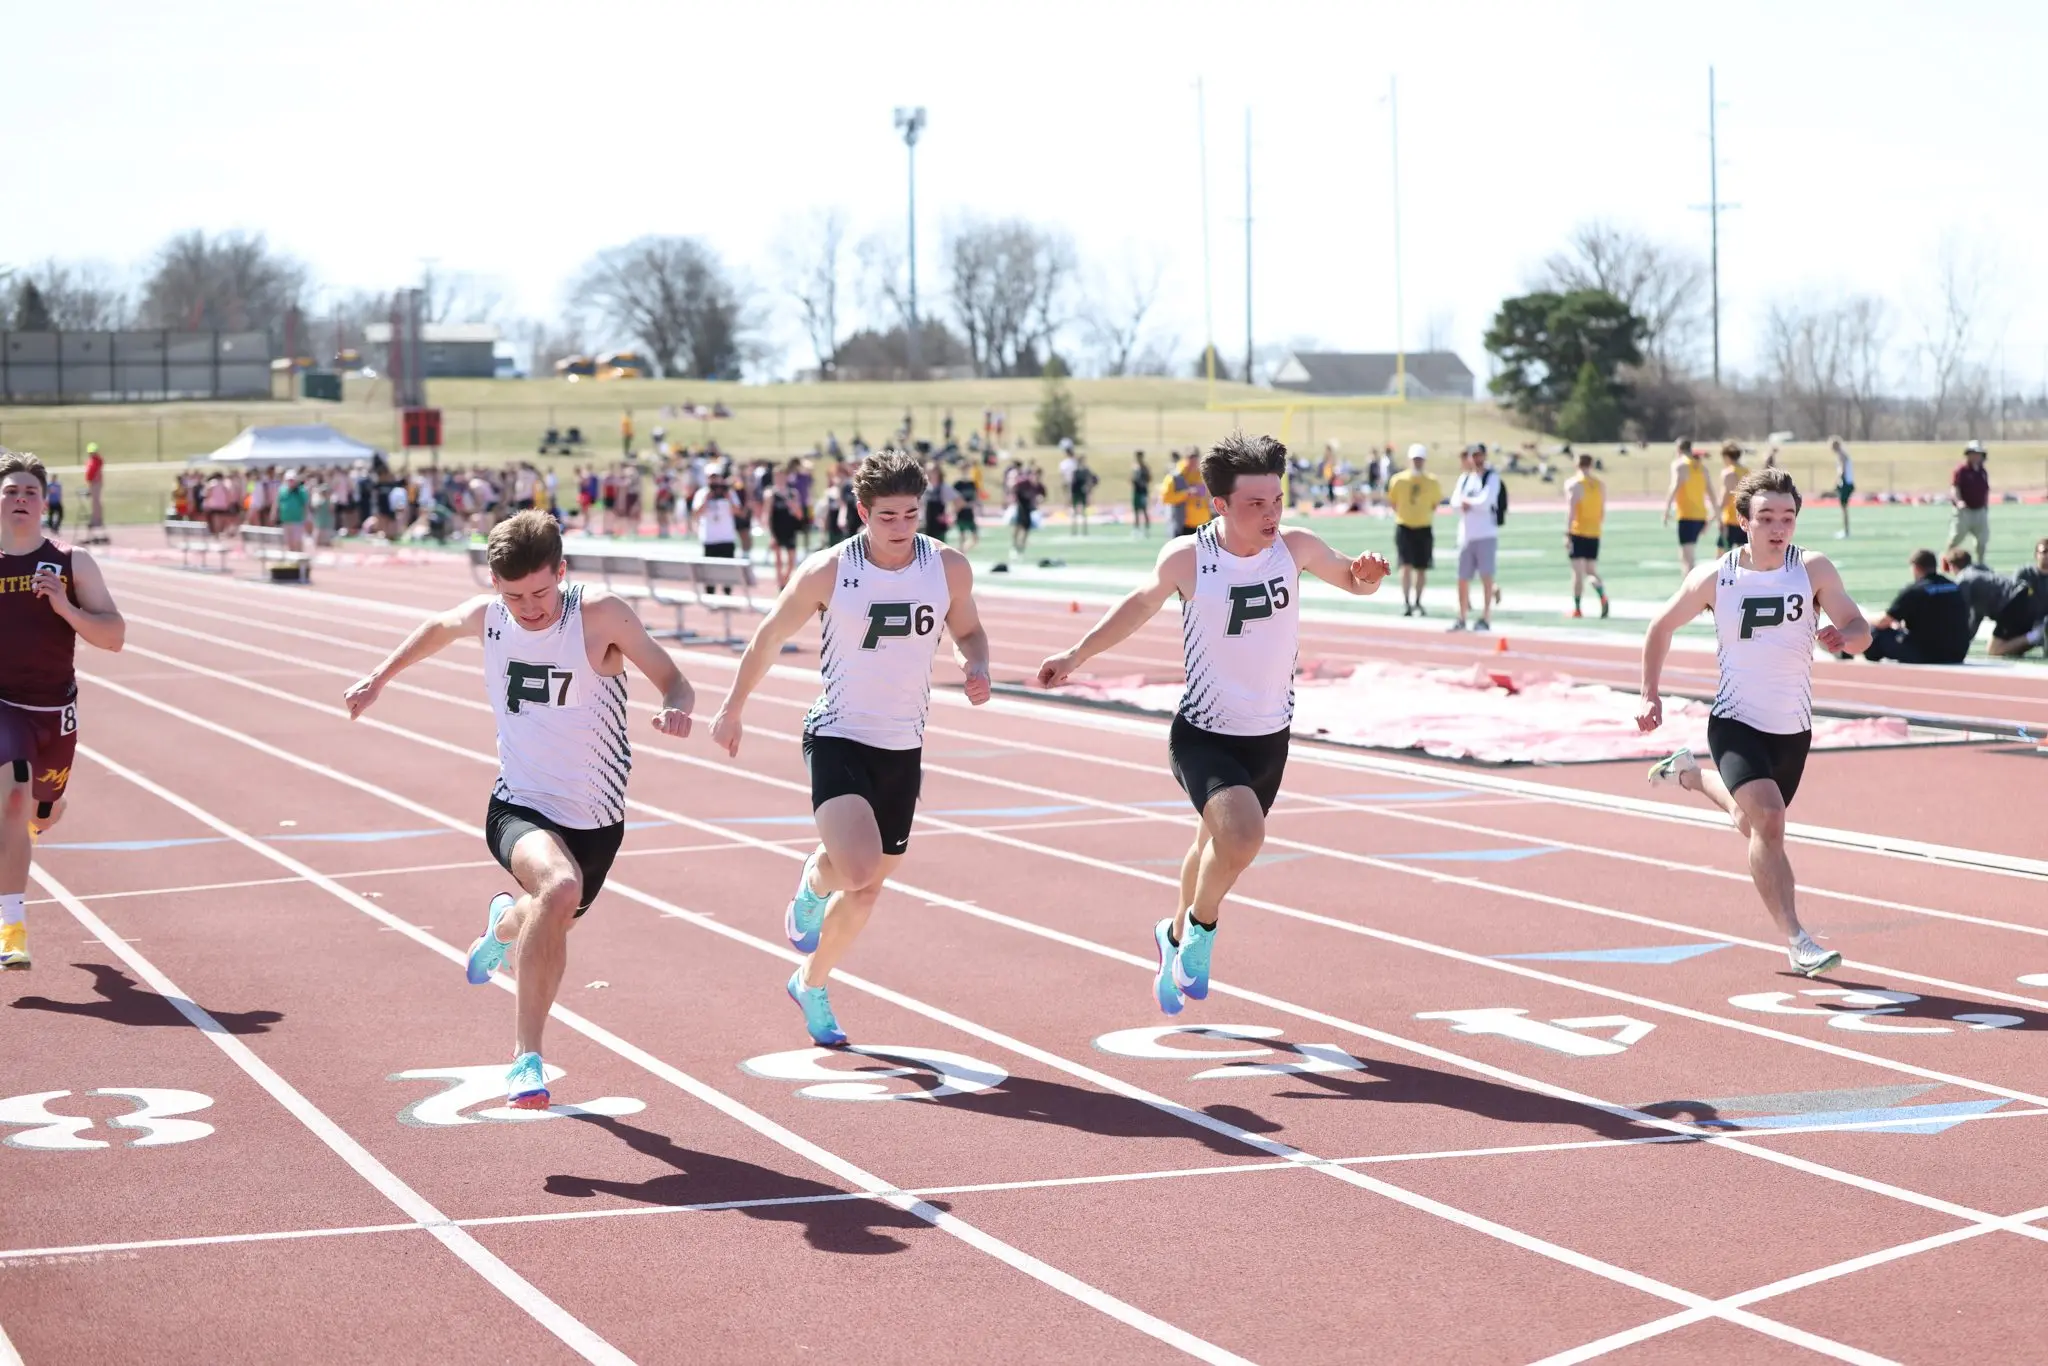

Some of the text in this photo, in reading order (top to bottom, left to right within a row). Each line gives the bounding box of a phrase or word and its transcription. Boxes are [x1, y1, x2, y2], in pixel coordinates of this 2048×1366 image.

[1224, 583, 1275, 637] P
[1268, 576, 1290, 609] 5
[1786, 594, 1804, 622] 3
[859, 600, 919, 651] P
[915, 605, 934, 635] 6
[1738, 595, 1785, 641] P
[504, 658, 559, 715] P
[551, 672, 573, 706] 7
[64, 706, 76, 732] 8
[1414, 1007, 1658, 1056] 4
[0, 1087, 216, 1149] 8
